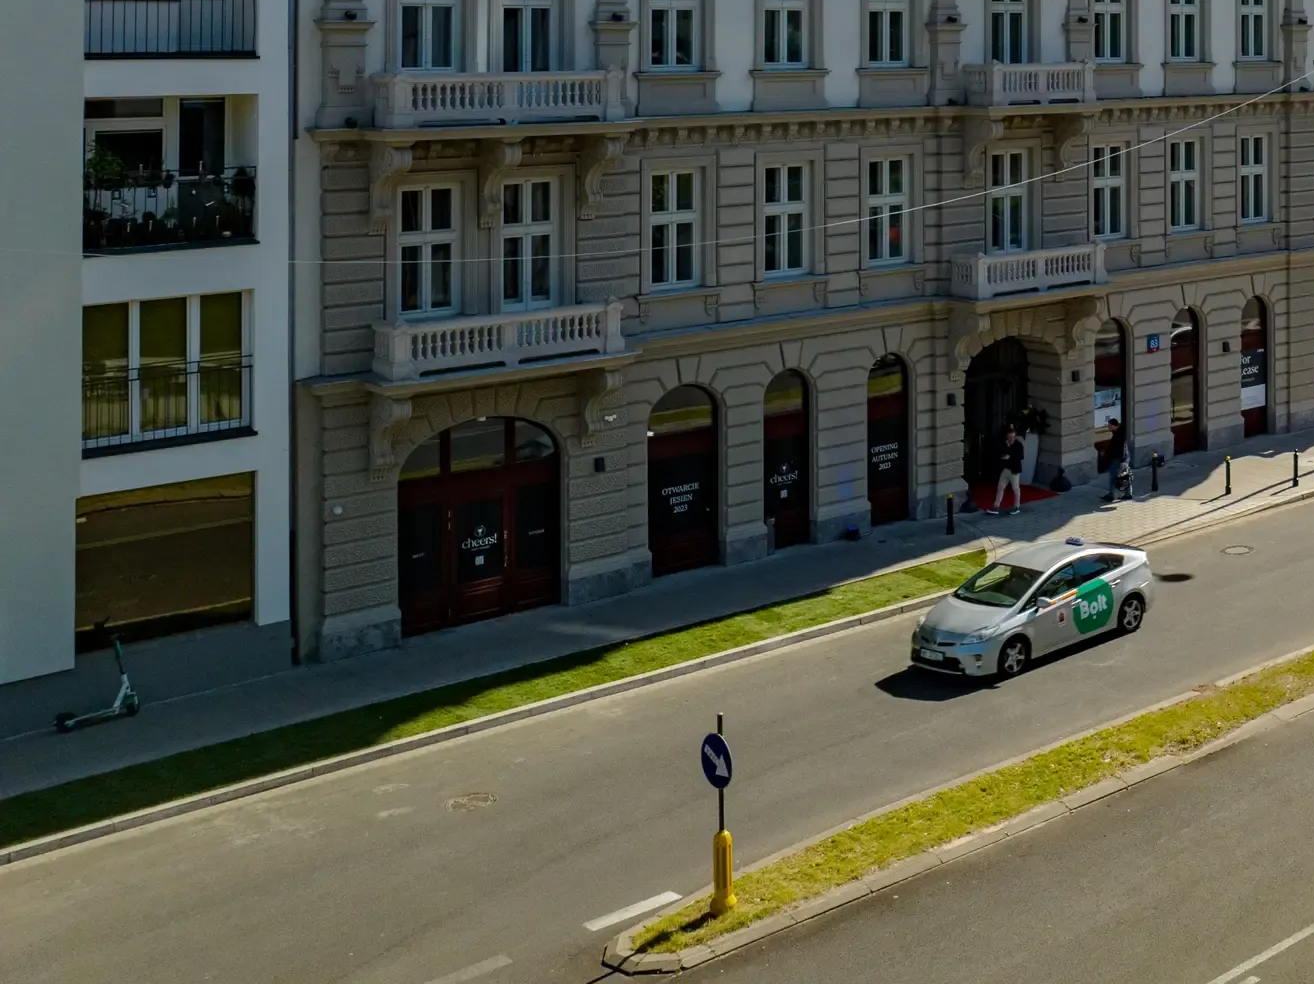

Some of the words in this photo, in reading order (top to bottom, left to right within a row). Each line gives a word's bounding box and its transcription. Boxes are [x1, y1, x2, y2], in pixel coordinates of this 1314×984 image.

[1150, 339, 1158, 349] 83
[1241, 365, 1259, 376] ease
[871, 442, 898, 454] OPENING
[871, 451, 898, 463] AUTUMN
[878, 461, 892, 471] 2023
[769, 470, 799, 484] cheers!
[661, 481, 701, 496] OTWARCIE
[672, 504, 688, 514] 2023
[461, 532, 498, 550] cheers!
[1079, 593, 1108, 620] Bolt
